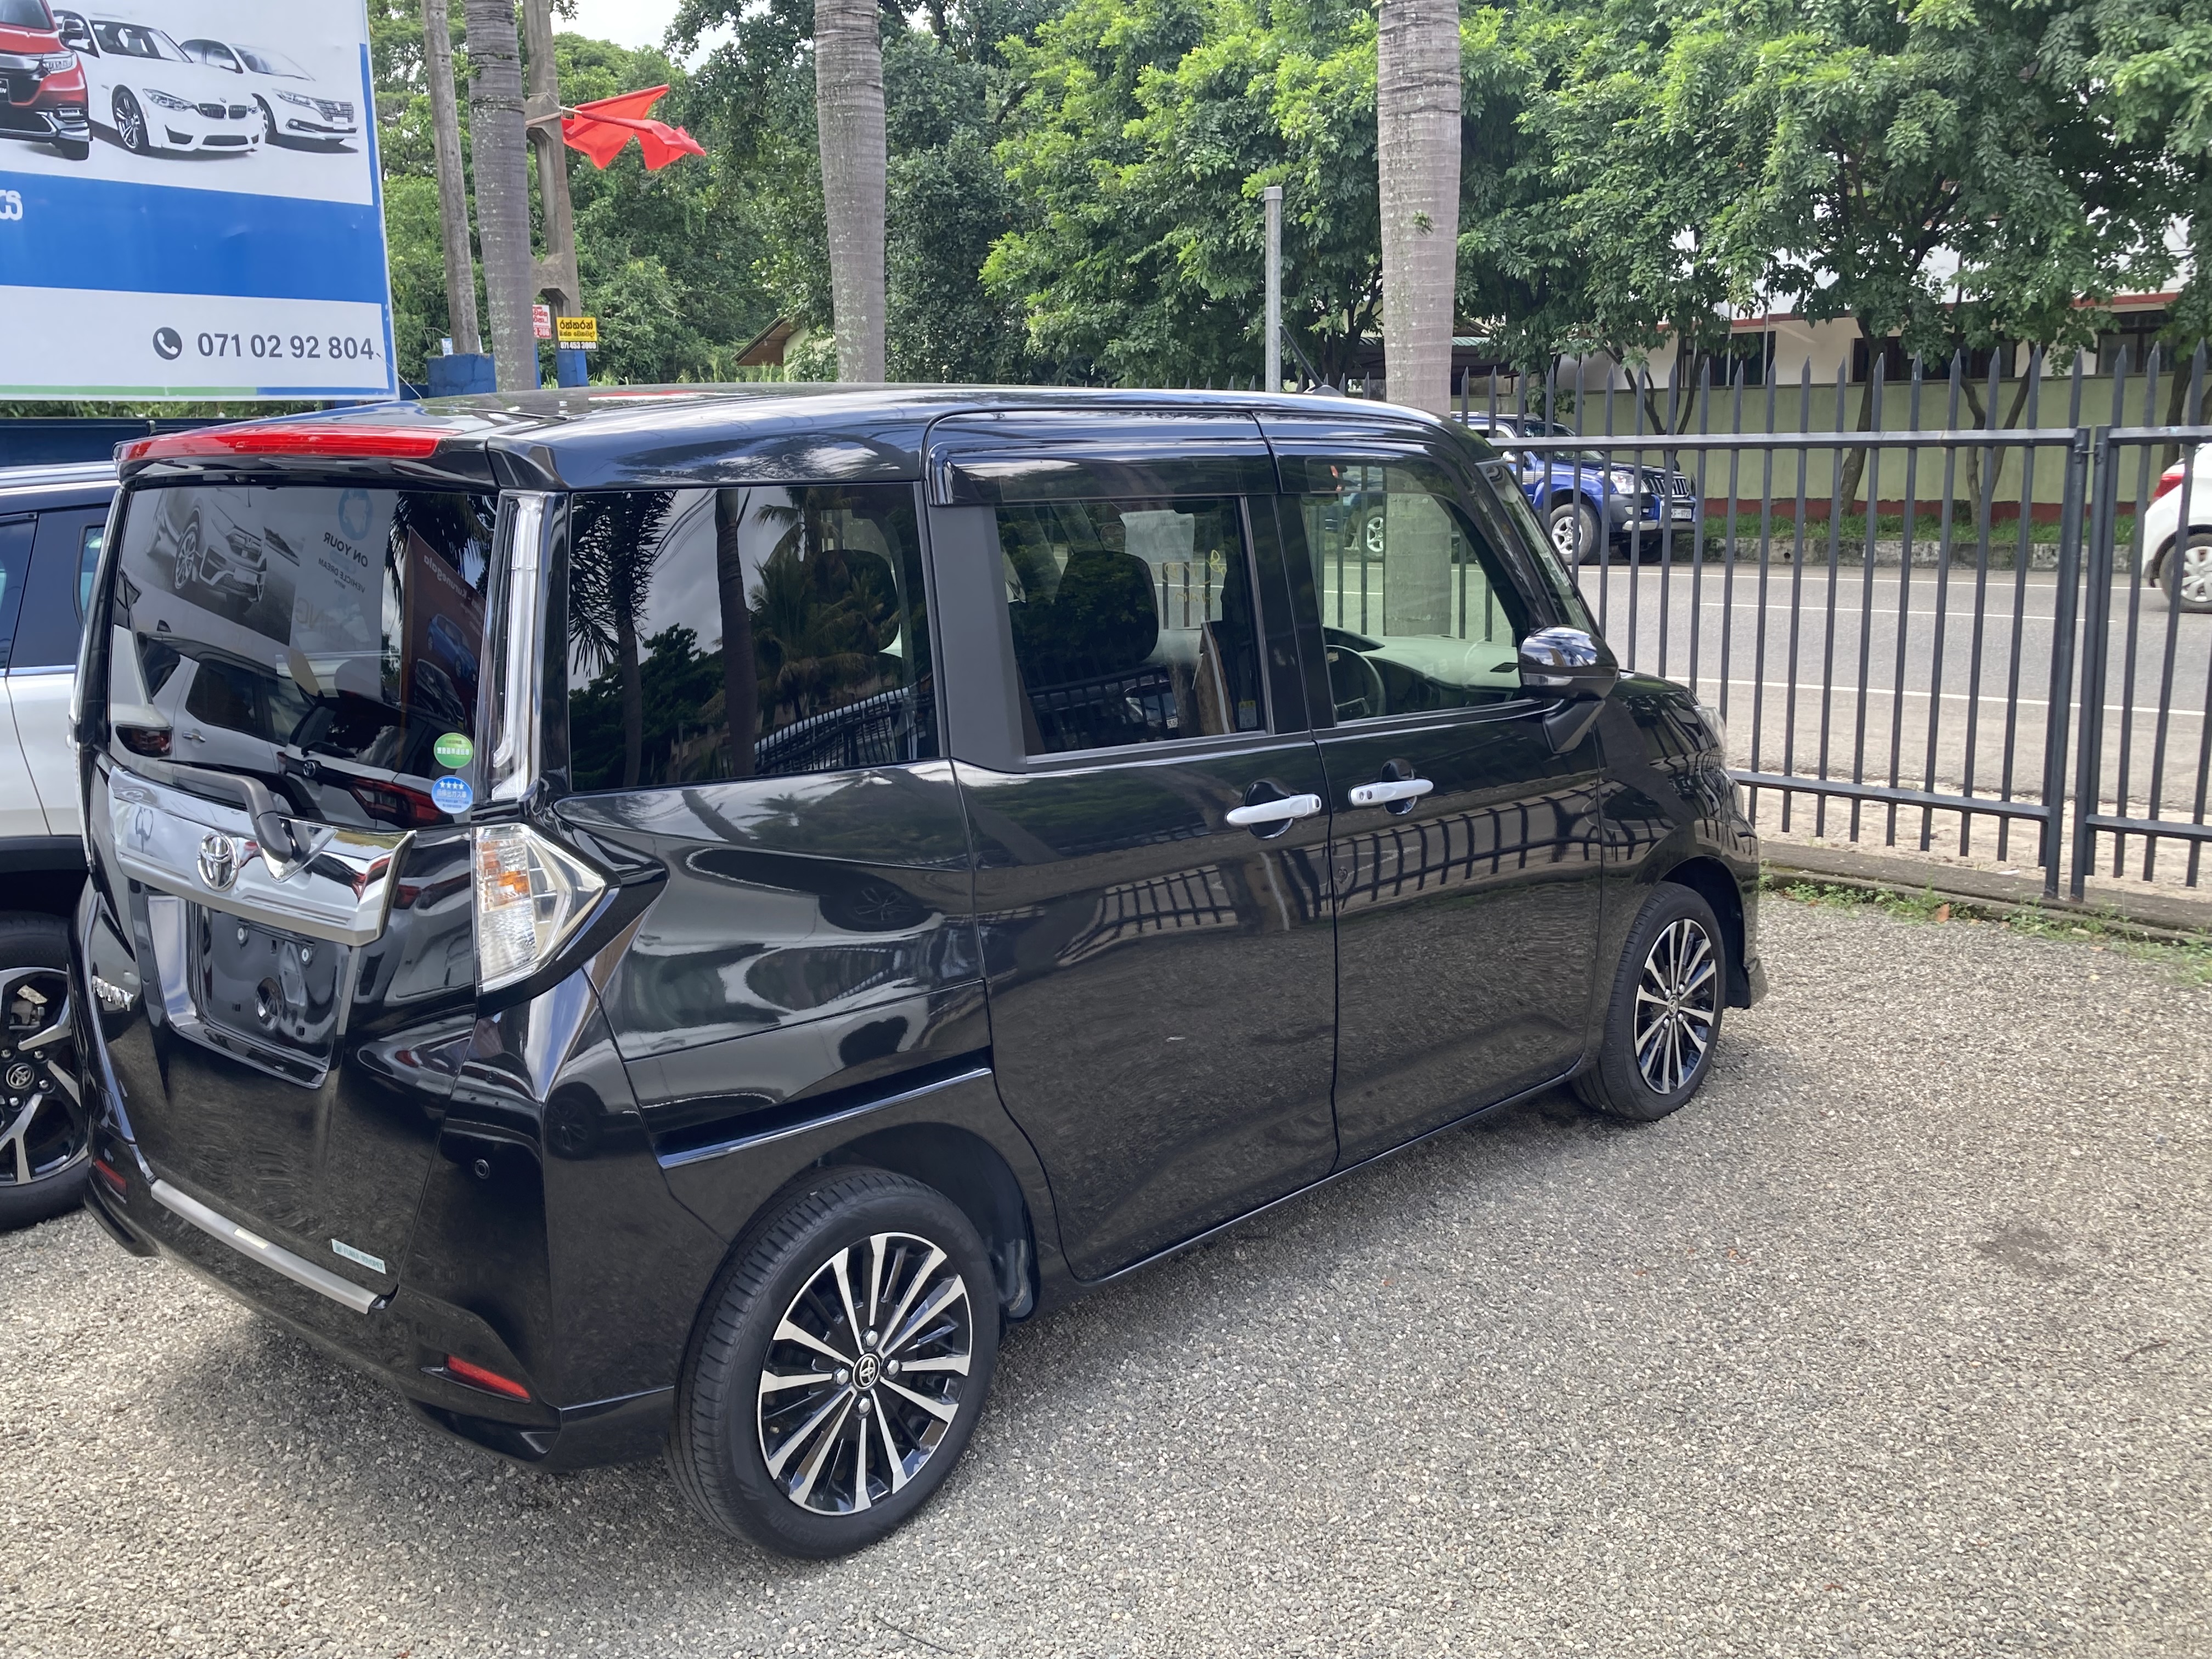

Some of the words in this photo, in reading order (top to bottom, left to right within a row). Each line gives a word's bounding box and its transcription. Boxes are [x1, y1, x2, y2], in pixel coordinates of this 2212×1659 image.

[198, 332, 241, 357] 071
[250, 334, 283, 358] 02
[290, 335, 320, 358] 92
[329, 336, 374, 360] 804
